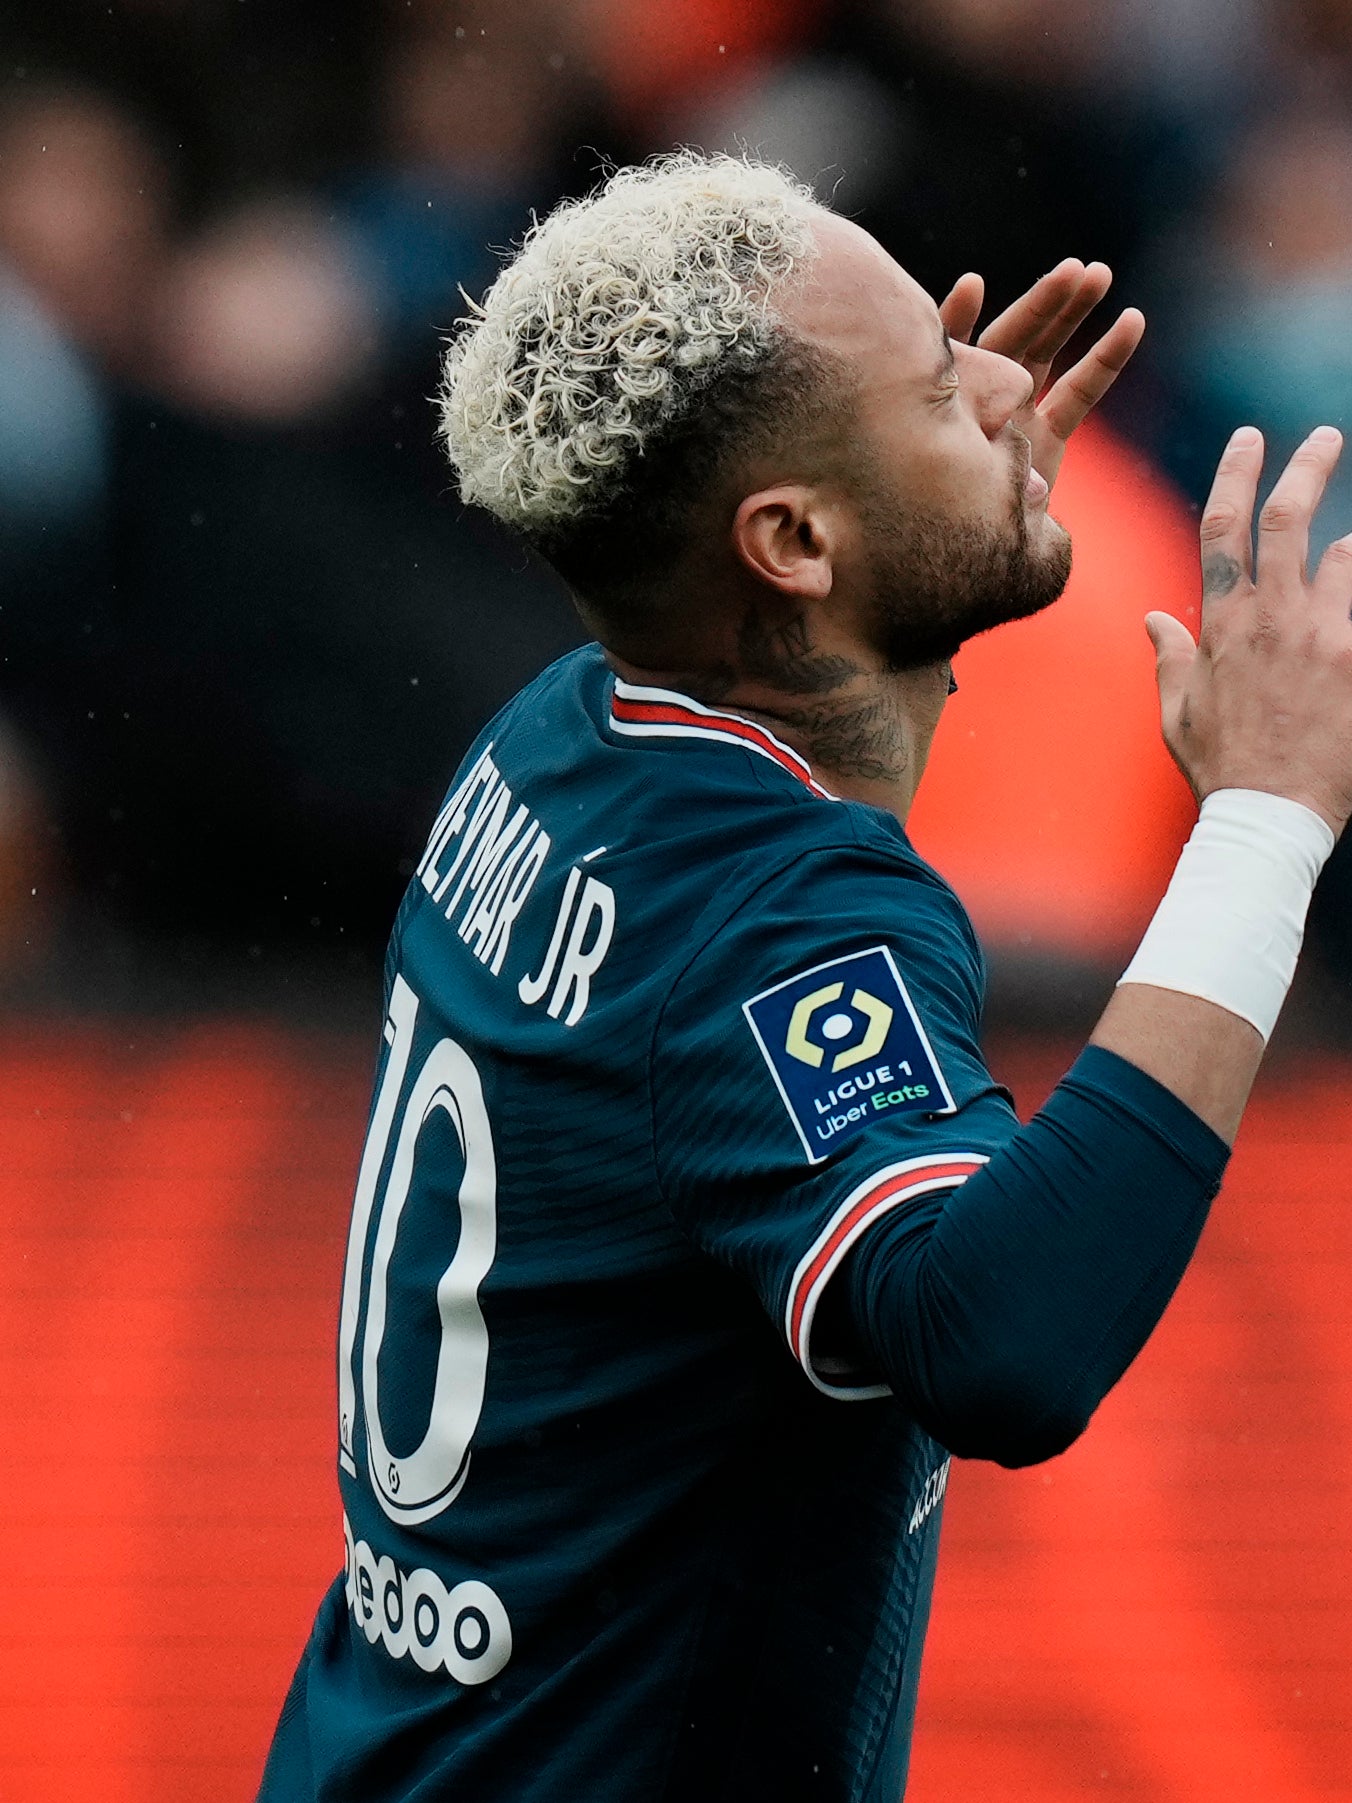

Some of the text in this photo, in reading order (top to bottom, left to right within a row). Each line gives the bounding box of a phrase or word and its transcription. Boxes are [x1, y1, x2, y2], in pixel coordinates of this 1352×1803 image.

[813, 1060, 913, 1114] LIGUE 1
[816, 1084, 930, 1140] Uber Eats
[339, 972, 495, 1525] 10
